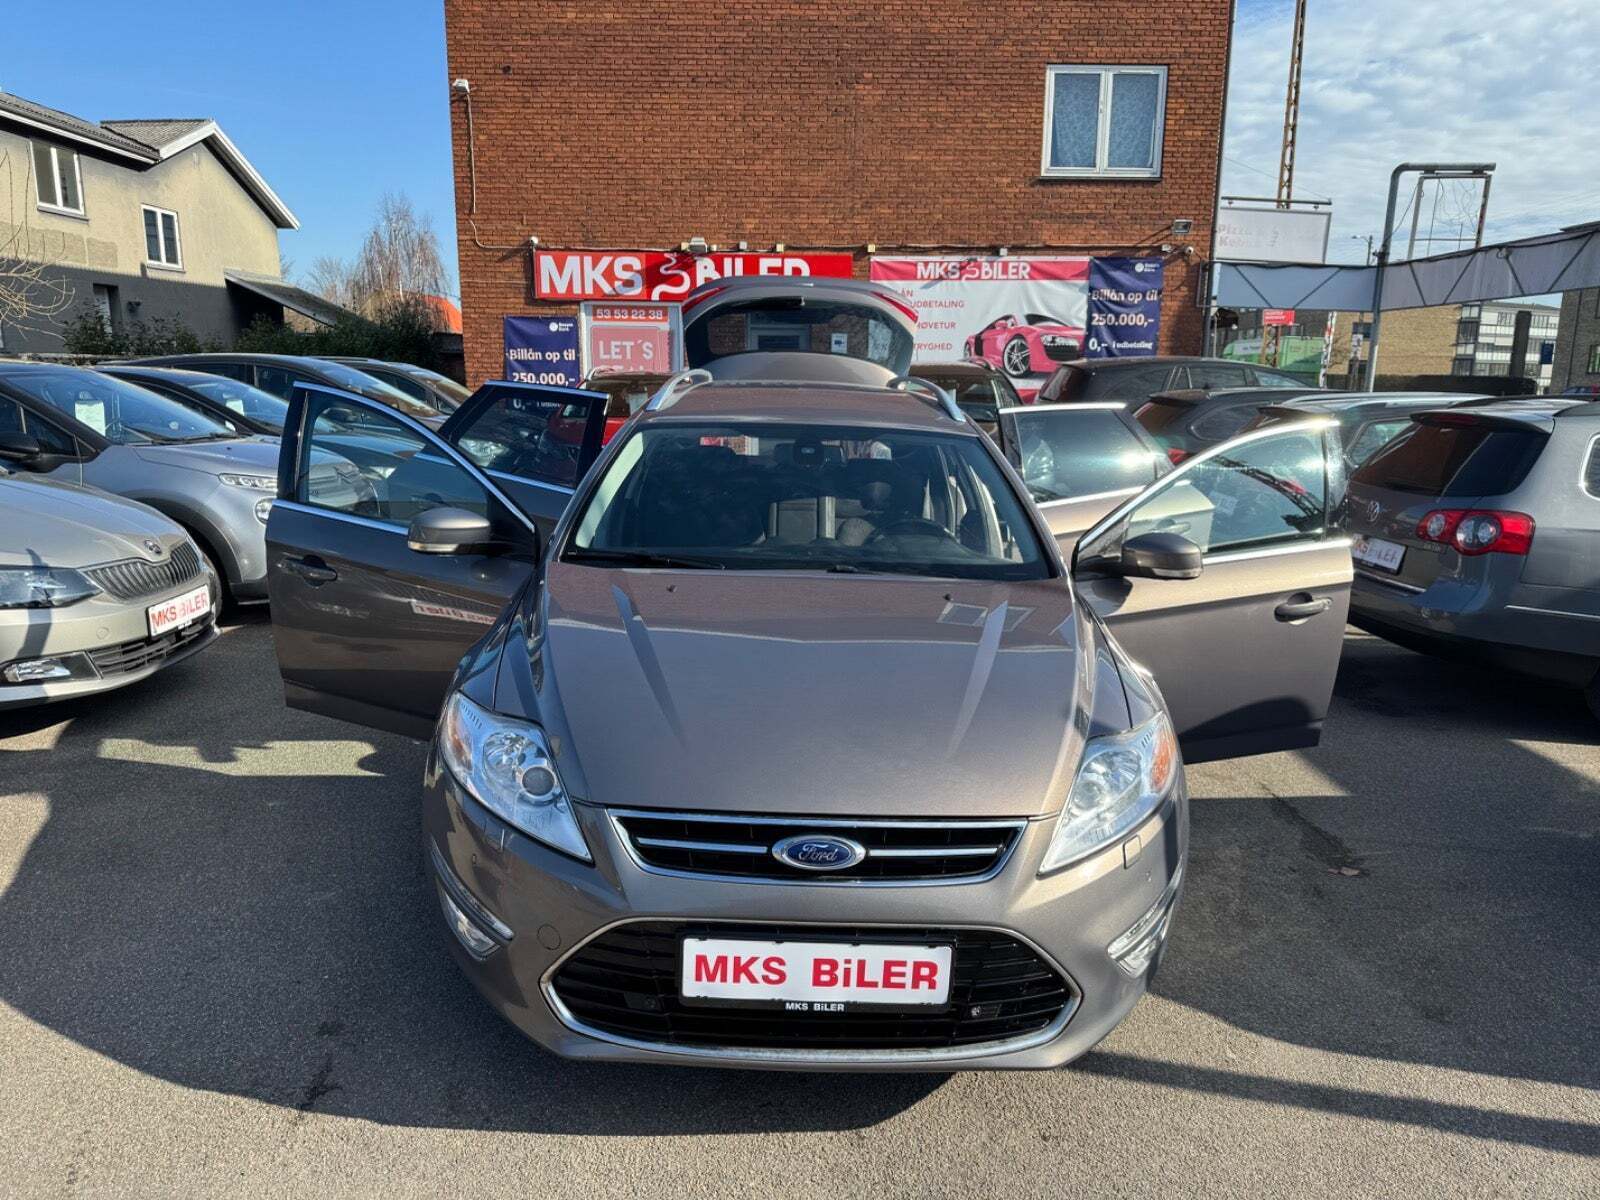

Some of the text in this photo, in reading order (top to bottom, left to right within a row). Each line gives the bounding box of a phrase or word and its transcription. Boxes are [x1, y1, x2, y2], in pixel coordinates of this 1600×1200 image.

[540, 255, 643, 296] MKS
[917, 262, 1032, 280] MKS BILER
[1092, 288, 1158, 304] Billån op til
[917, 321, 956, 330] ØVETUR
[1091, 313, 1155, 328] 250.000,-
[509, 348, 576, 364] Billån op til
[512, 372, 576, 387] 250.000,-
[798, 843, 839, 861] Ford
[694, 954, 939, 991] MKS BiLER
[785, 1002, 809, 1011] MKS
